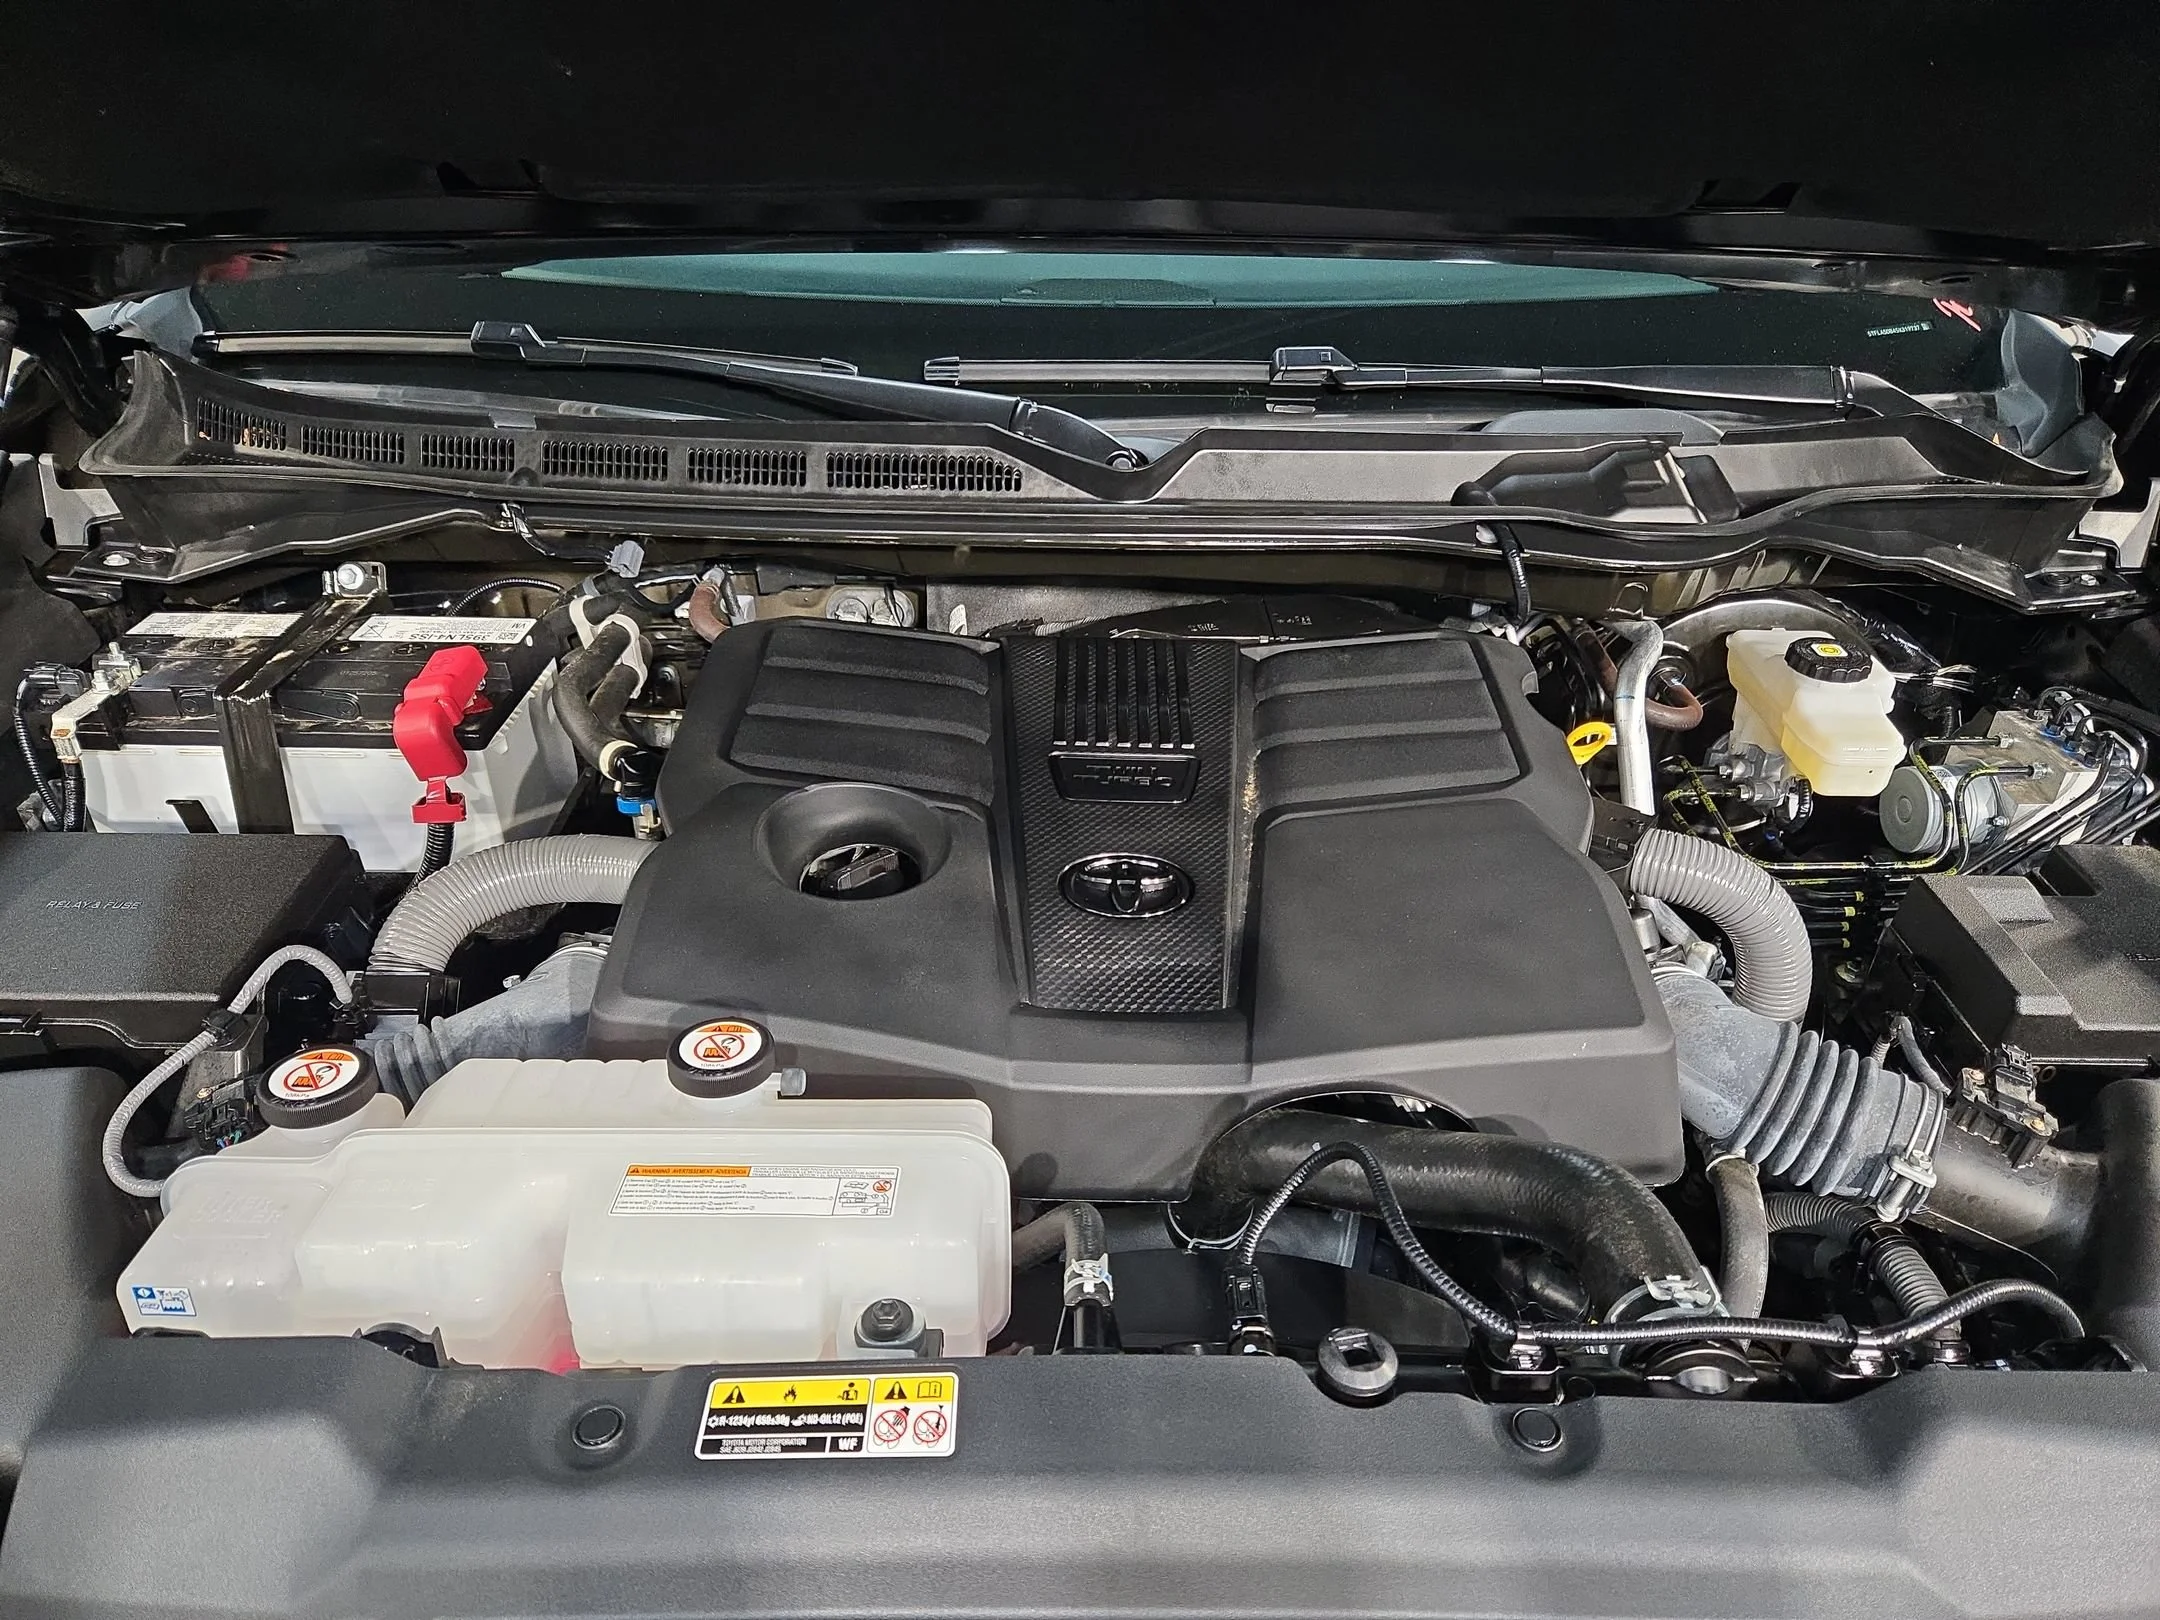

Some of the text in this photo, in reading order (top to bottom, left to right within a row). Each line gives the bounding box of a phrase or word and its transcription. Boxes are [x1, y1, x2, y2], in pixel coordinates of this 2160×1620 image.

[46, 900, 89, 909] RELAY
[103, 900, 143, 910] FUSE
[838, 1437, 858, 1451] WF
